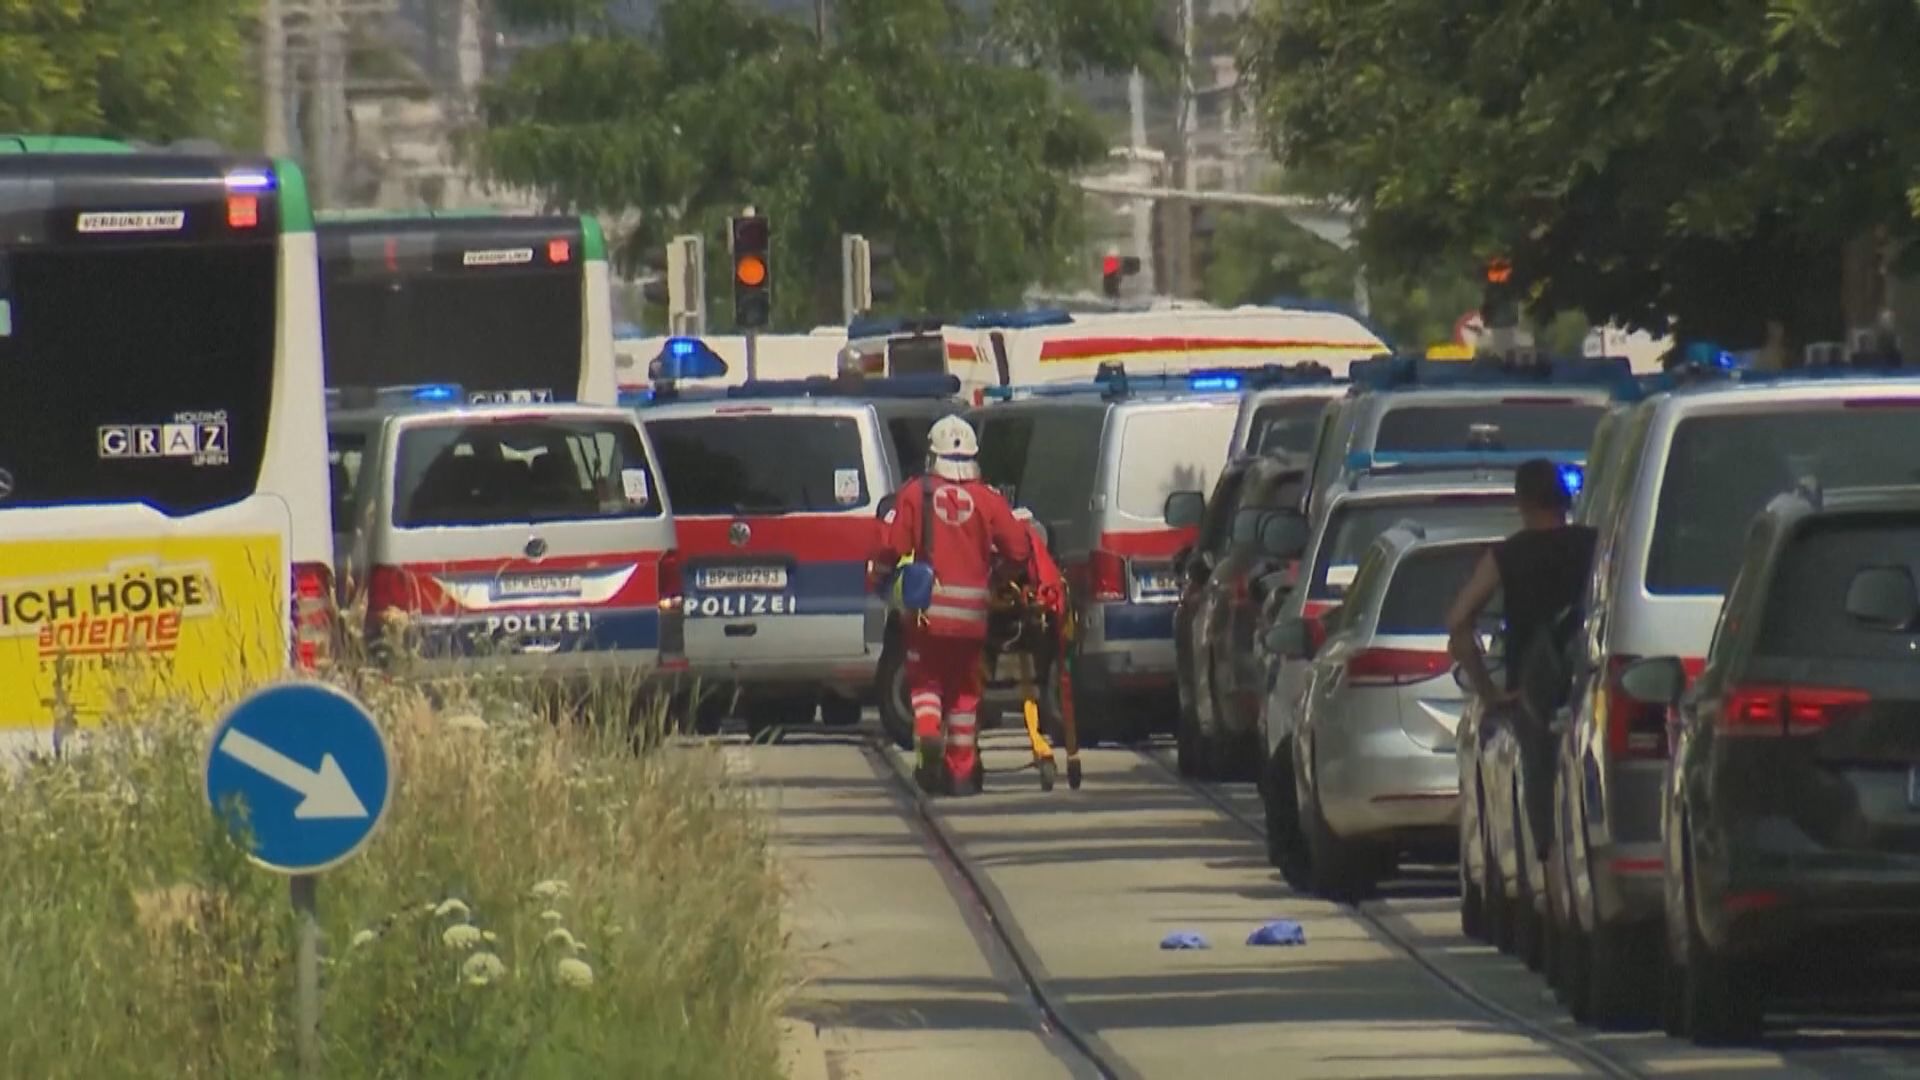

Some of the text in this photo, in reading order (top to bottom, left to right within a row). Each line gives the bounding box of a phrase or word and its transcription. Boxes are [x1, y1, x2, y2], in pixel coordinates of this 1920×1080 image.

[83, 214, 177, 227] VERBUND LINIE
[174, 409, 227, 423] HOLDING
[101, 425, 224, 456] GRAZ
[1, 572, 203, 625] ICH HÖRE
[683, 594, 796, 616] POLIZEI
[39, 610, 181, 648] antenne
[487, 611, 591, 635] POLIZEI
